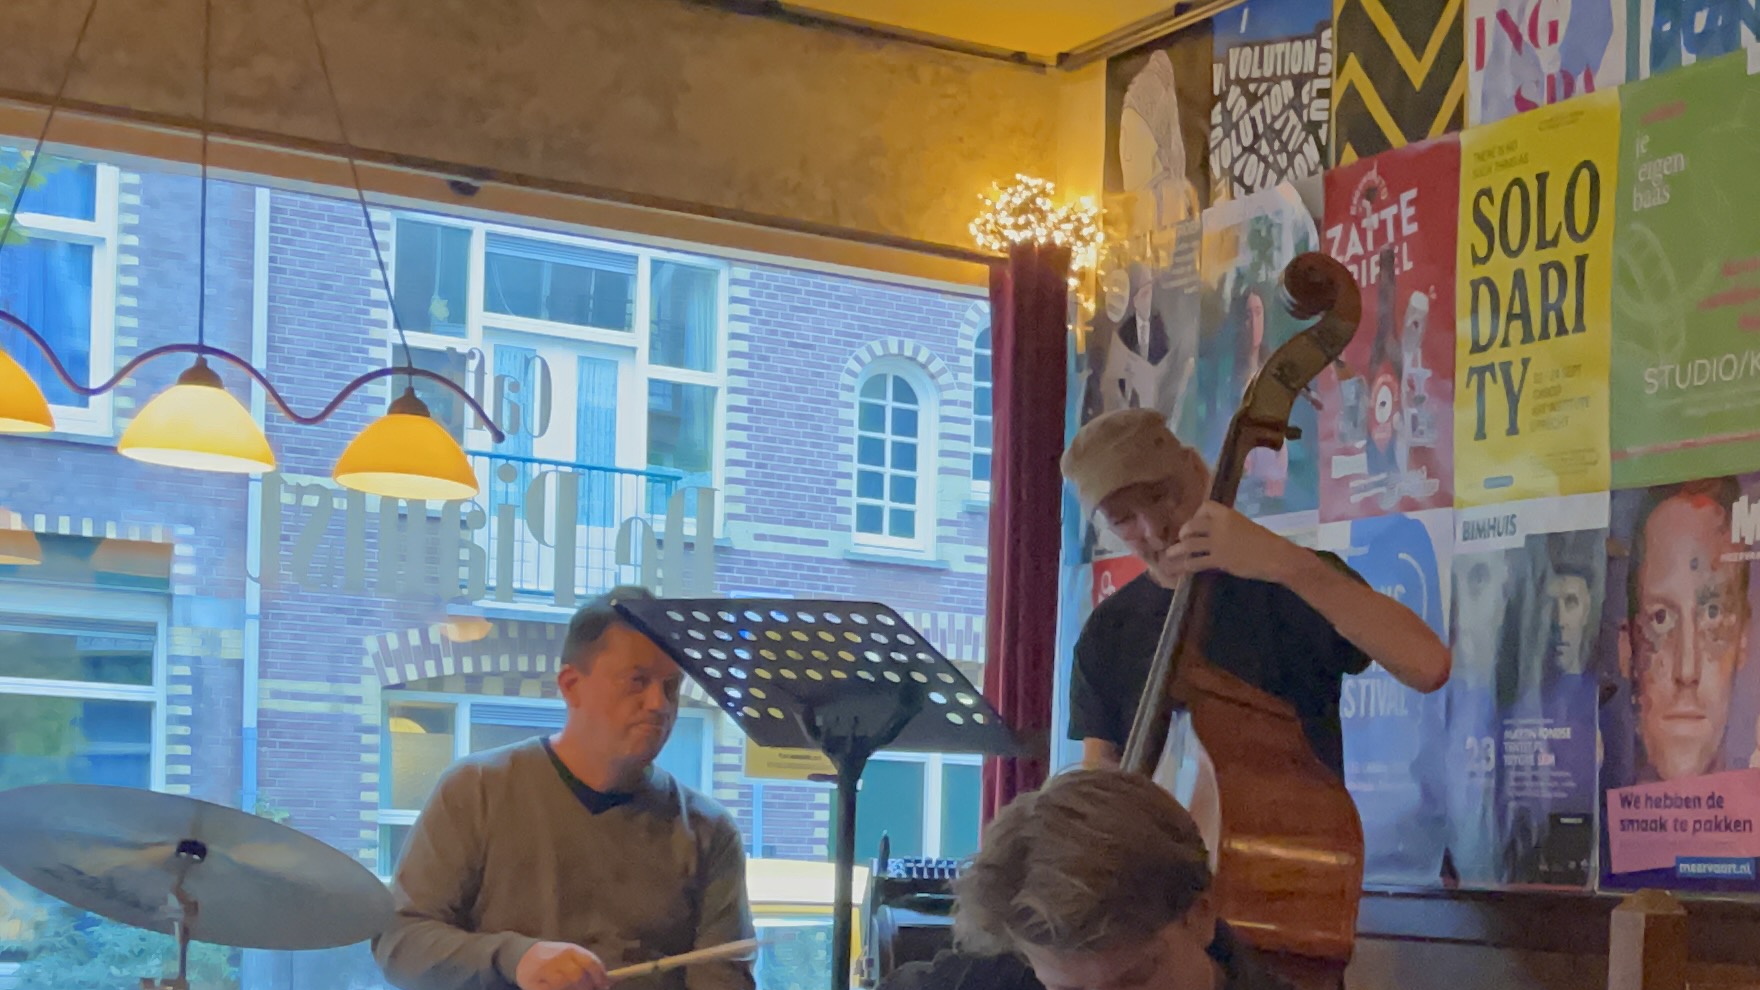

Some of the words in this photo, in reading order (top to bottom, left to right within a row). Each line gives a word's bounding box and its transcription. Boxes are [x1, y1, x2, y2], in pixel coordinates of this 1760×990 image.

[1229, 39, 1317, 80] VOLUTION
[1638, 153, 1686, 187] eigen
[1326, 188, 1418, 264] ZATTE
[1470, 160, 1600, 268] SOLO
[1469, 253, 1589, 355] DARI
[1465, 357, 1531, 441] TY
[1462, 513, 1517, 542] BIMHUIS
[1344, 678, 1409, 720] STIVAL
[1619, 792, 1641, 810] We
[1644, 793, 1702, 810] hebben
[1706, 791, 1725, 810] de
[1619, 815, 1668, 833] smaak
[1673, 817, 1689, 833] te
[1692, 814, 1753, 837] pakken
[1679, 862, 1751, 876] meervaart.nl
